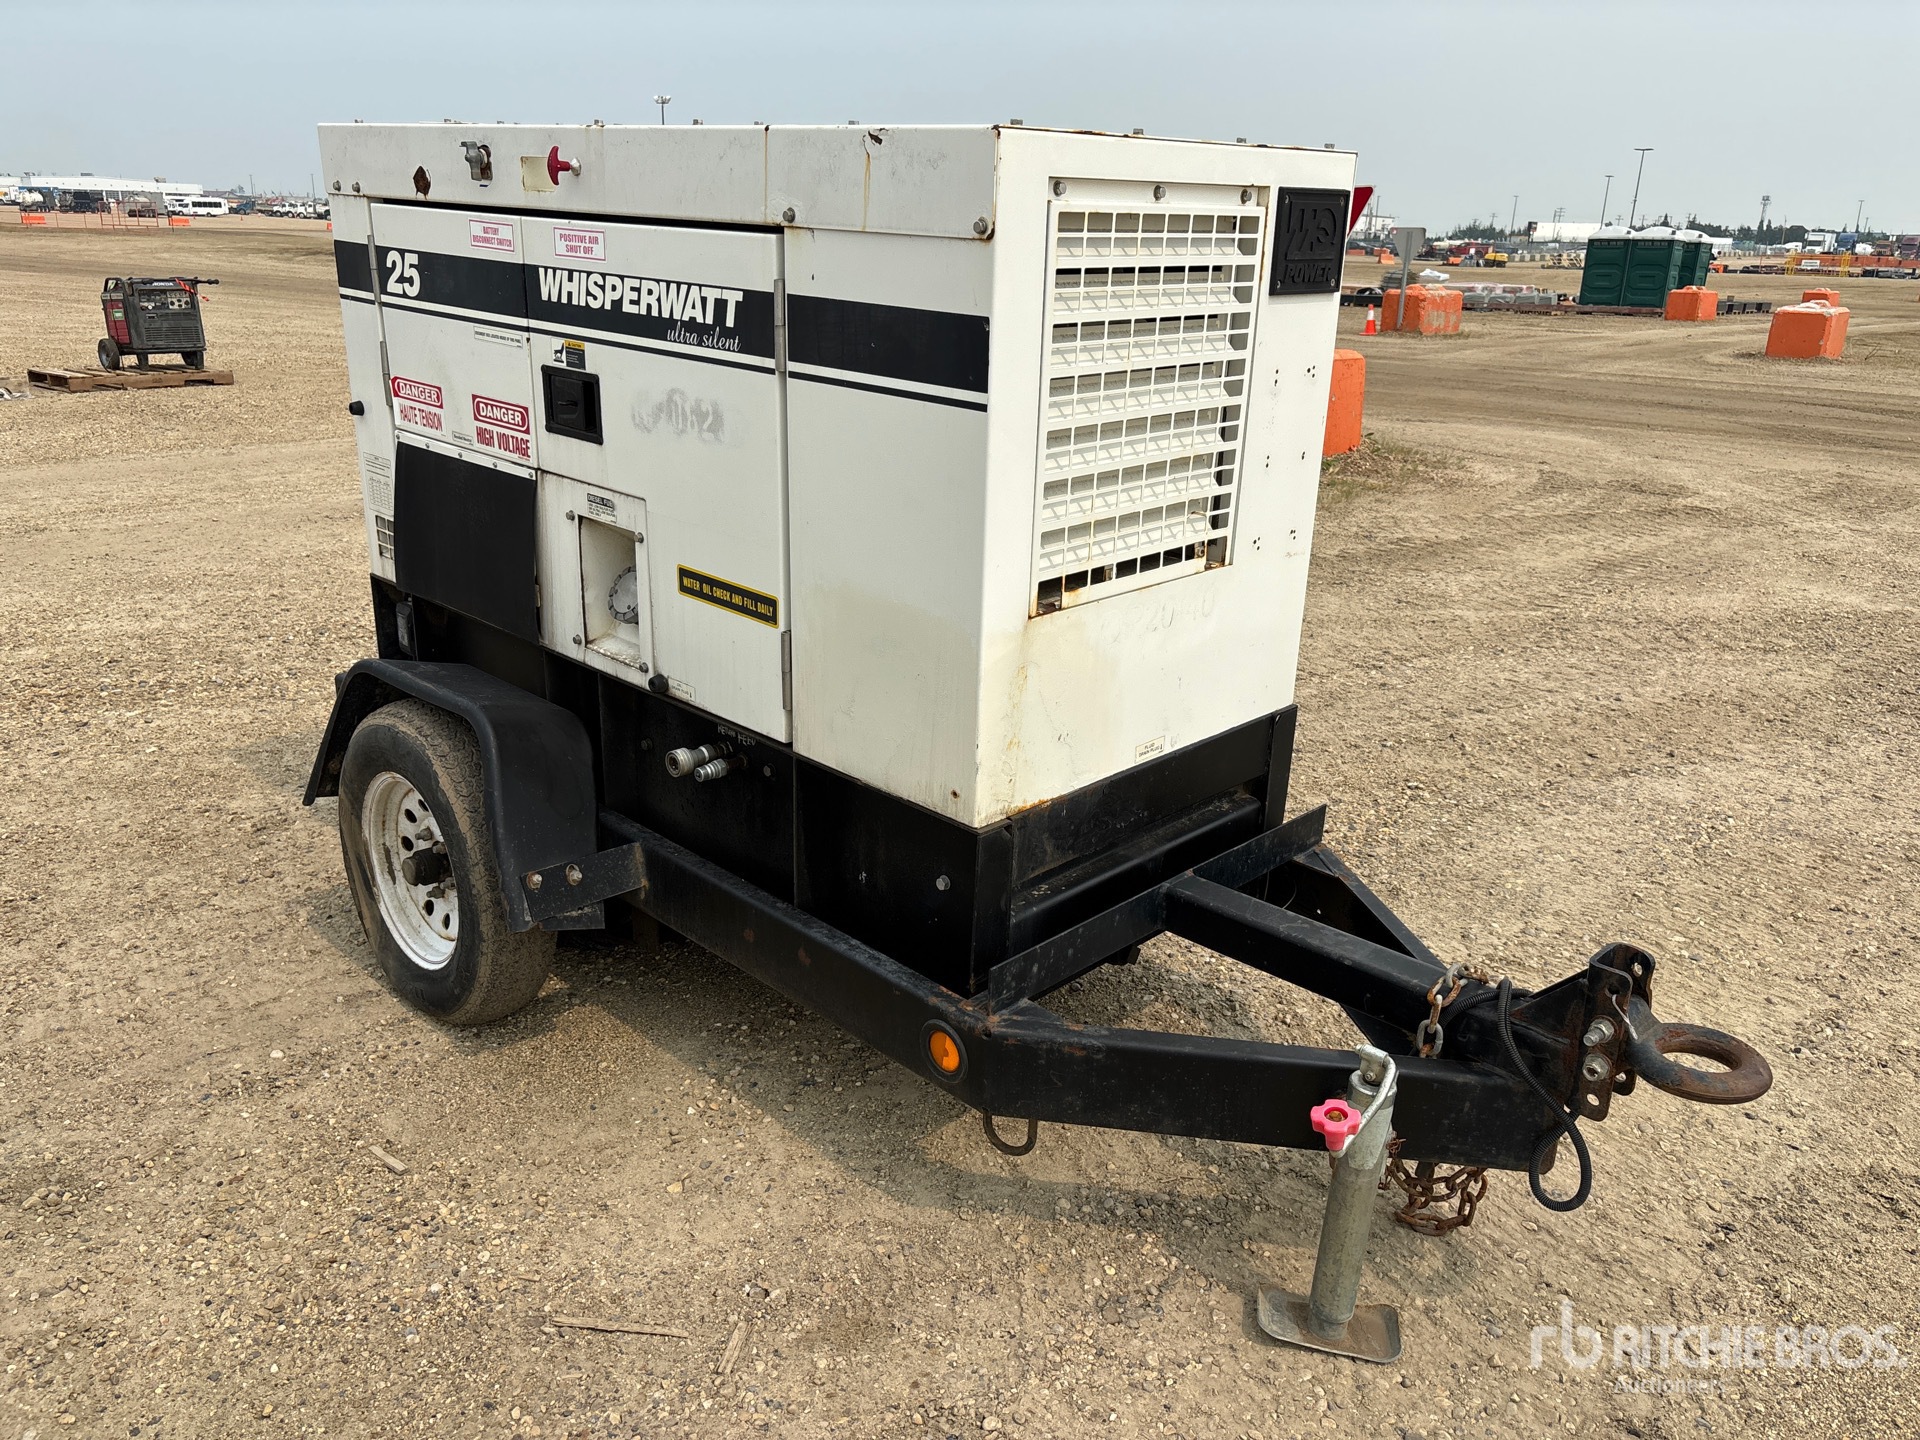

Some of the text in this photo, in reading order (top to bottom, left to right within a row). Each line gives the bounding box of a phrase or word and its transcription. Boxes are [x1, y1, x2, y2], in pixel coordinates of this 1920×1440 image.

[559, 233, 599, 246] POSITIVE AIR
[565, 244, 594, 256] SHUT OFF
[386, 250, 421, 297] 25
[1283, 263, 1332, 284] POWER
[538, 267, 744, 328] WHISPERWATT
[667, 321, 742, 352] ultra silent
[399, 382, 438, 403] DANGER
[399, 402, 443, 432] HAUTE TENSION
[479, 403, 523, 426] DANGER
[476, 425, 531, 458] HIGH VOLTAGE
[588, 495, 603, 504] DIESEL
[682, 576, 773, 617] WATER OIL CHECK AND FILL DAILY
